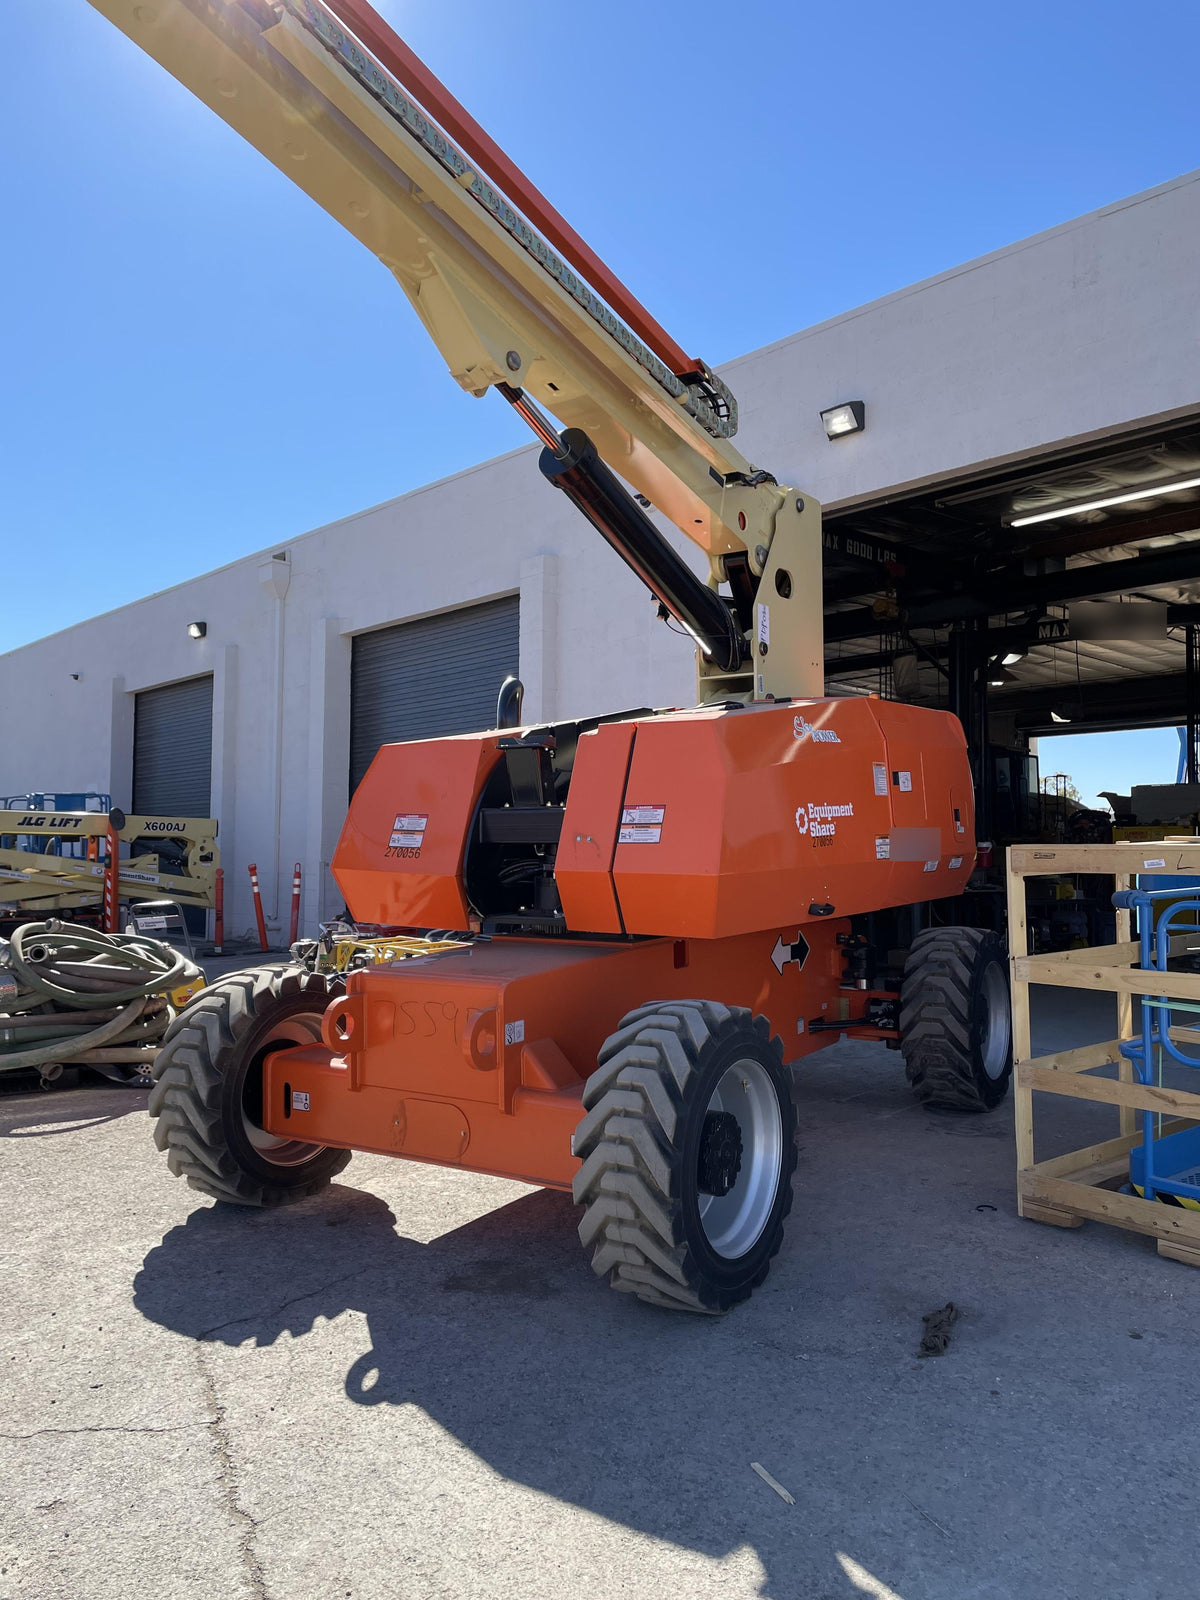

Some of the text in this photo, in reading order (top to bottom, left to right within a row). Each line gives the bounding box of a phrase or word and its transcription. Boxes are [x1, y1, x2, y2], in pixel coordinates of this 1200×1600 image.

[846, 538, 873, 561] 6000
[1038, 621, 1070, 639] MAX
[807, 802, 854, 821] Equipment
[17, 816, 83, 828] JLG LIFT
[143, 821, 186, 832] X600AJ
[810, 820, 836, 837] Share
[384, 847, 421, 859] 270056
